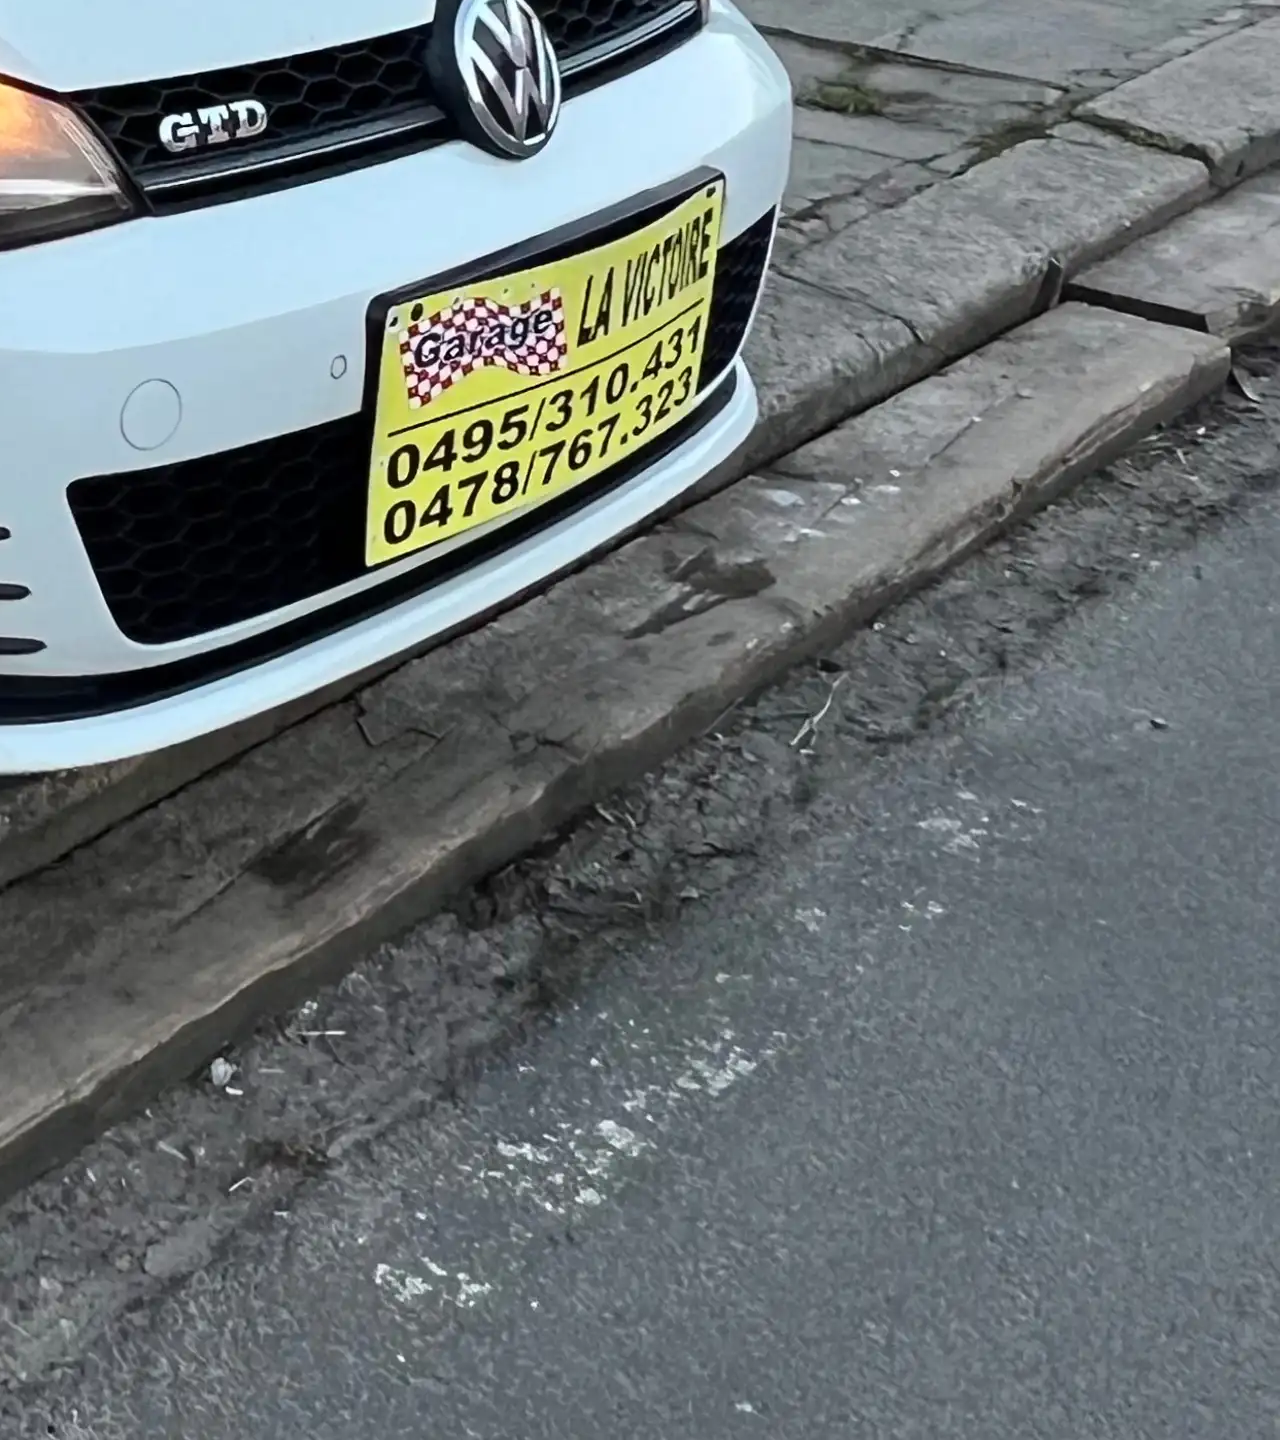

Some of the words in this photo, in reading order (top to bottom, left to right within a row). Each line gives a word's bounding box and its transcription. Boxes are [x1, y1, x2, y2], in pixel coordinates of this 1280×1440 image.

[159, 99, 268, 153] GTD
[414, 308, 555, 368] Garage
[576, 266, 614, 348] LA
[622, 207, 714, 327] VICTOIRE
[384, 366, 692, 545] 0478/767.323
[387, 315, 701, 489] 0495/310.431
